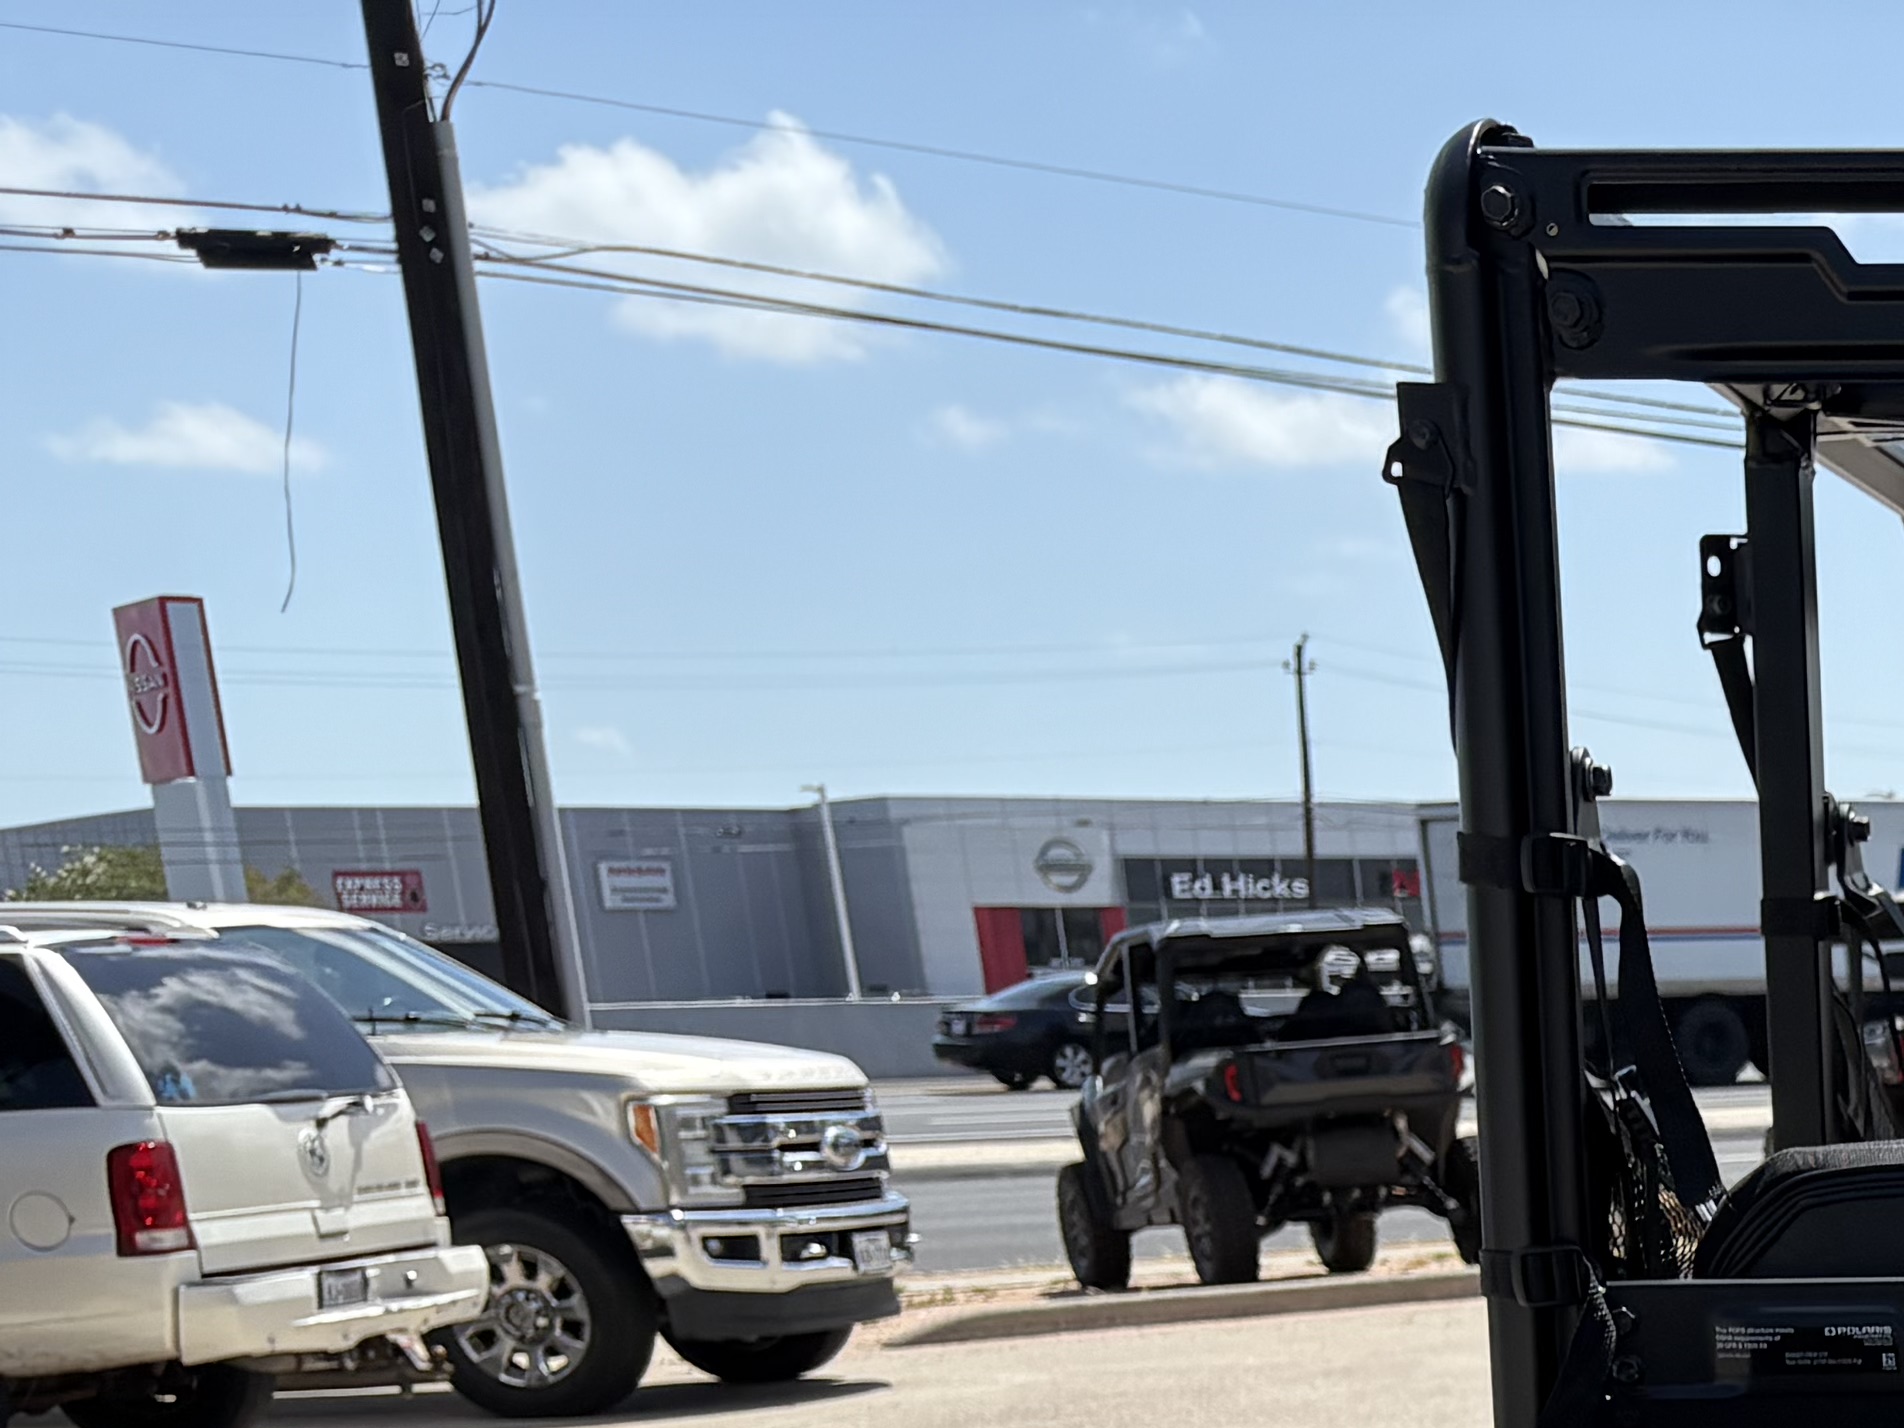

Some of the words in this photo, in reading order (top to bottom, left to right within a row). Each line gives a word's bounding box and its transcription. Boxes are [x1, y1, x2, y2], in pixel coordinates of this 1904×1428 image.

[1170, 871, 1213, 899] Ed
[1220, 871, 1310, 899] Hicks
[424, 922, 500, 941] Servic
